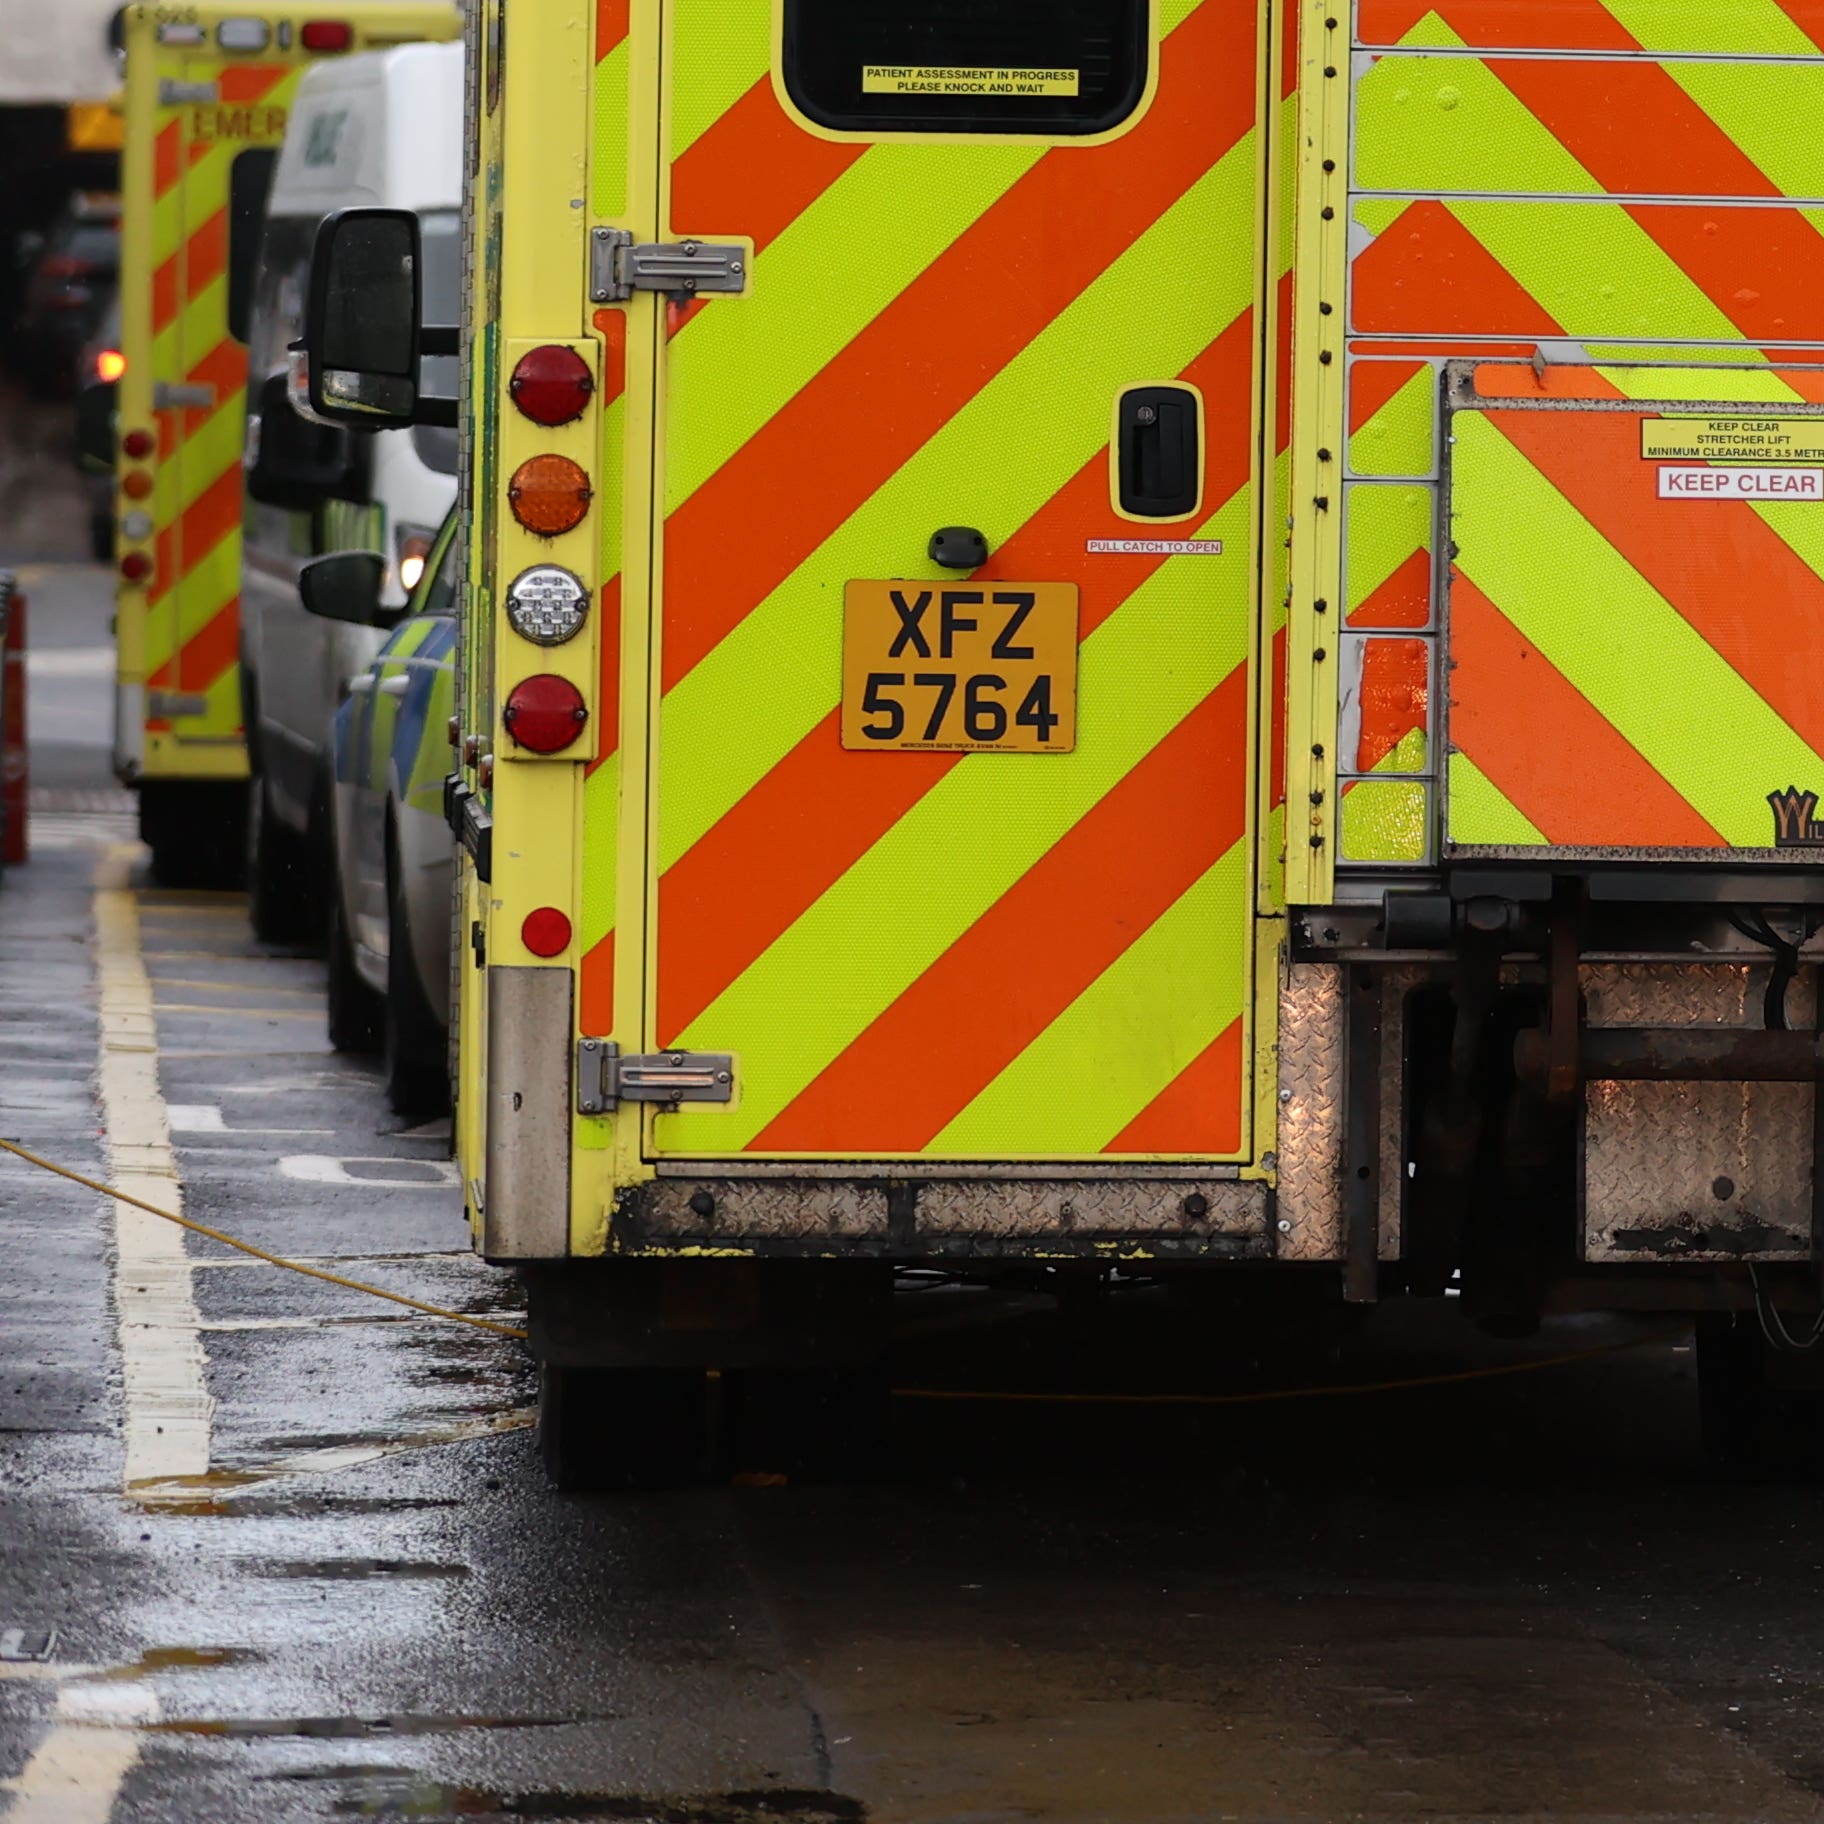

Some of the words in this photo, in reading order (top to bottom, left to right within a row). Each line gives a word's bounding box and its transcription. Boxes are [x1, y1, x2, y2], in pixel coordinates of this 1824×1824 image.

[867, 69, 913, 79] PATIENT
[917, 70, 994, 80] ASSESSMENT
[997, 71, 1008, 80] IN
[1012, 71, 1075, 81] PROGRESS
[897, 82, 941, 92] PLEASE
[945, 83, 985, 93] KNOCK
[989, 84, 1013, 93] AND
[1016, 84, 1045, 93] WAIT
[1708, 422, 1738, 431] KEEP
[1741, 423, 1780, 432] CLEAR
[1696, 435, 1765, 445] STRETCHER
[1768, 436, 1791, 445] LIFT
[1648, 447, 1700, 457] MINIMUM
[1703, 448, 1772, 458] CLEARANCE
[1775, 449, 1791, 458] 3.5
[1668, 473, 1730, 491] KEEP
[1737, 474, 1816, 493] CLEAR
[1090, 541, 1120, 551] PULL
[1123, 542, 1163, 552] CATCH
[1167, 542, 1183, 552] TO
[1186, 543, 1219, 553] OPEN
[888, 590, 1036, 660] XFZ
[861, 672, 1058, 742] 5764
